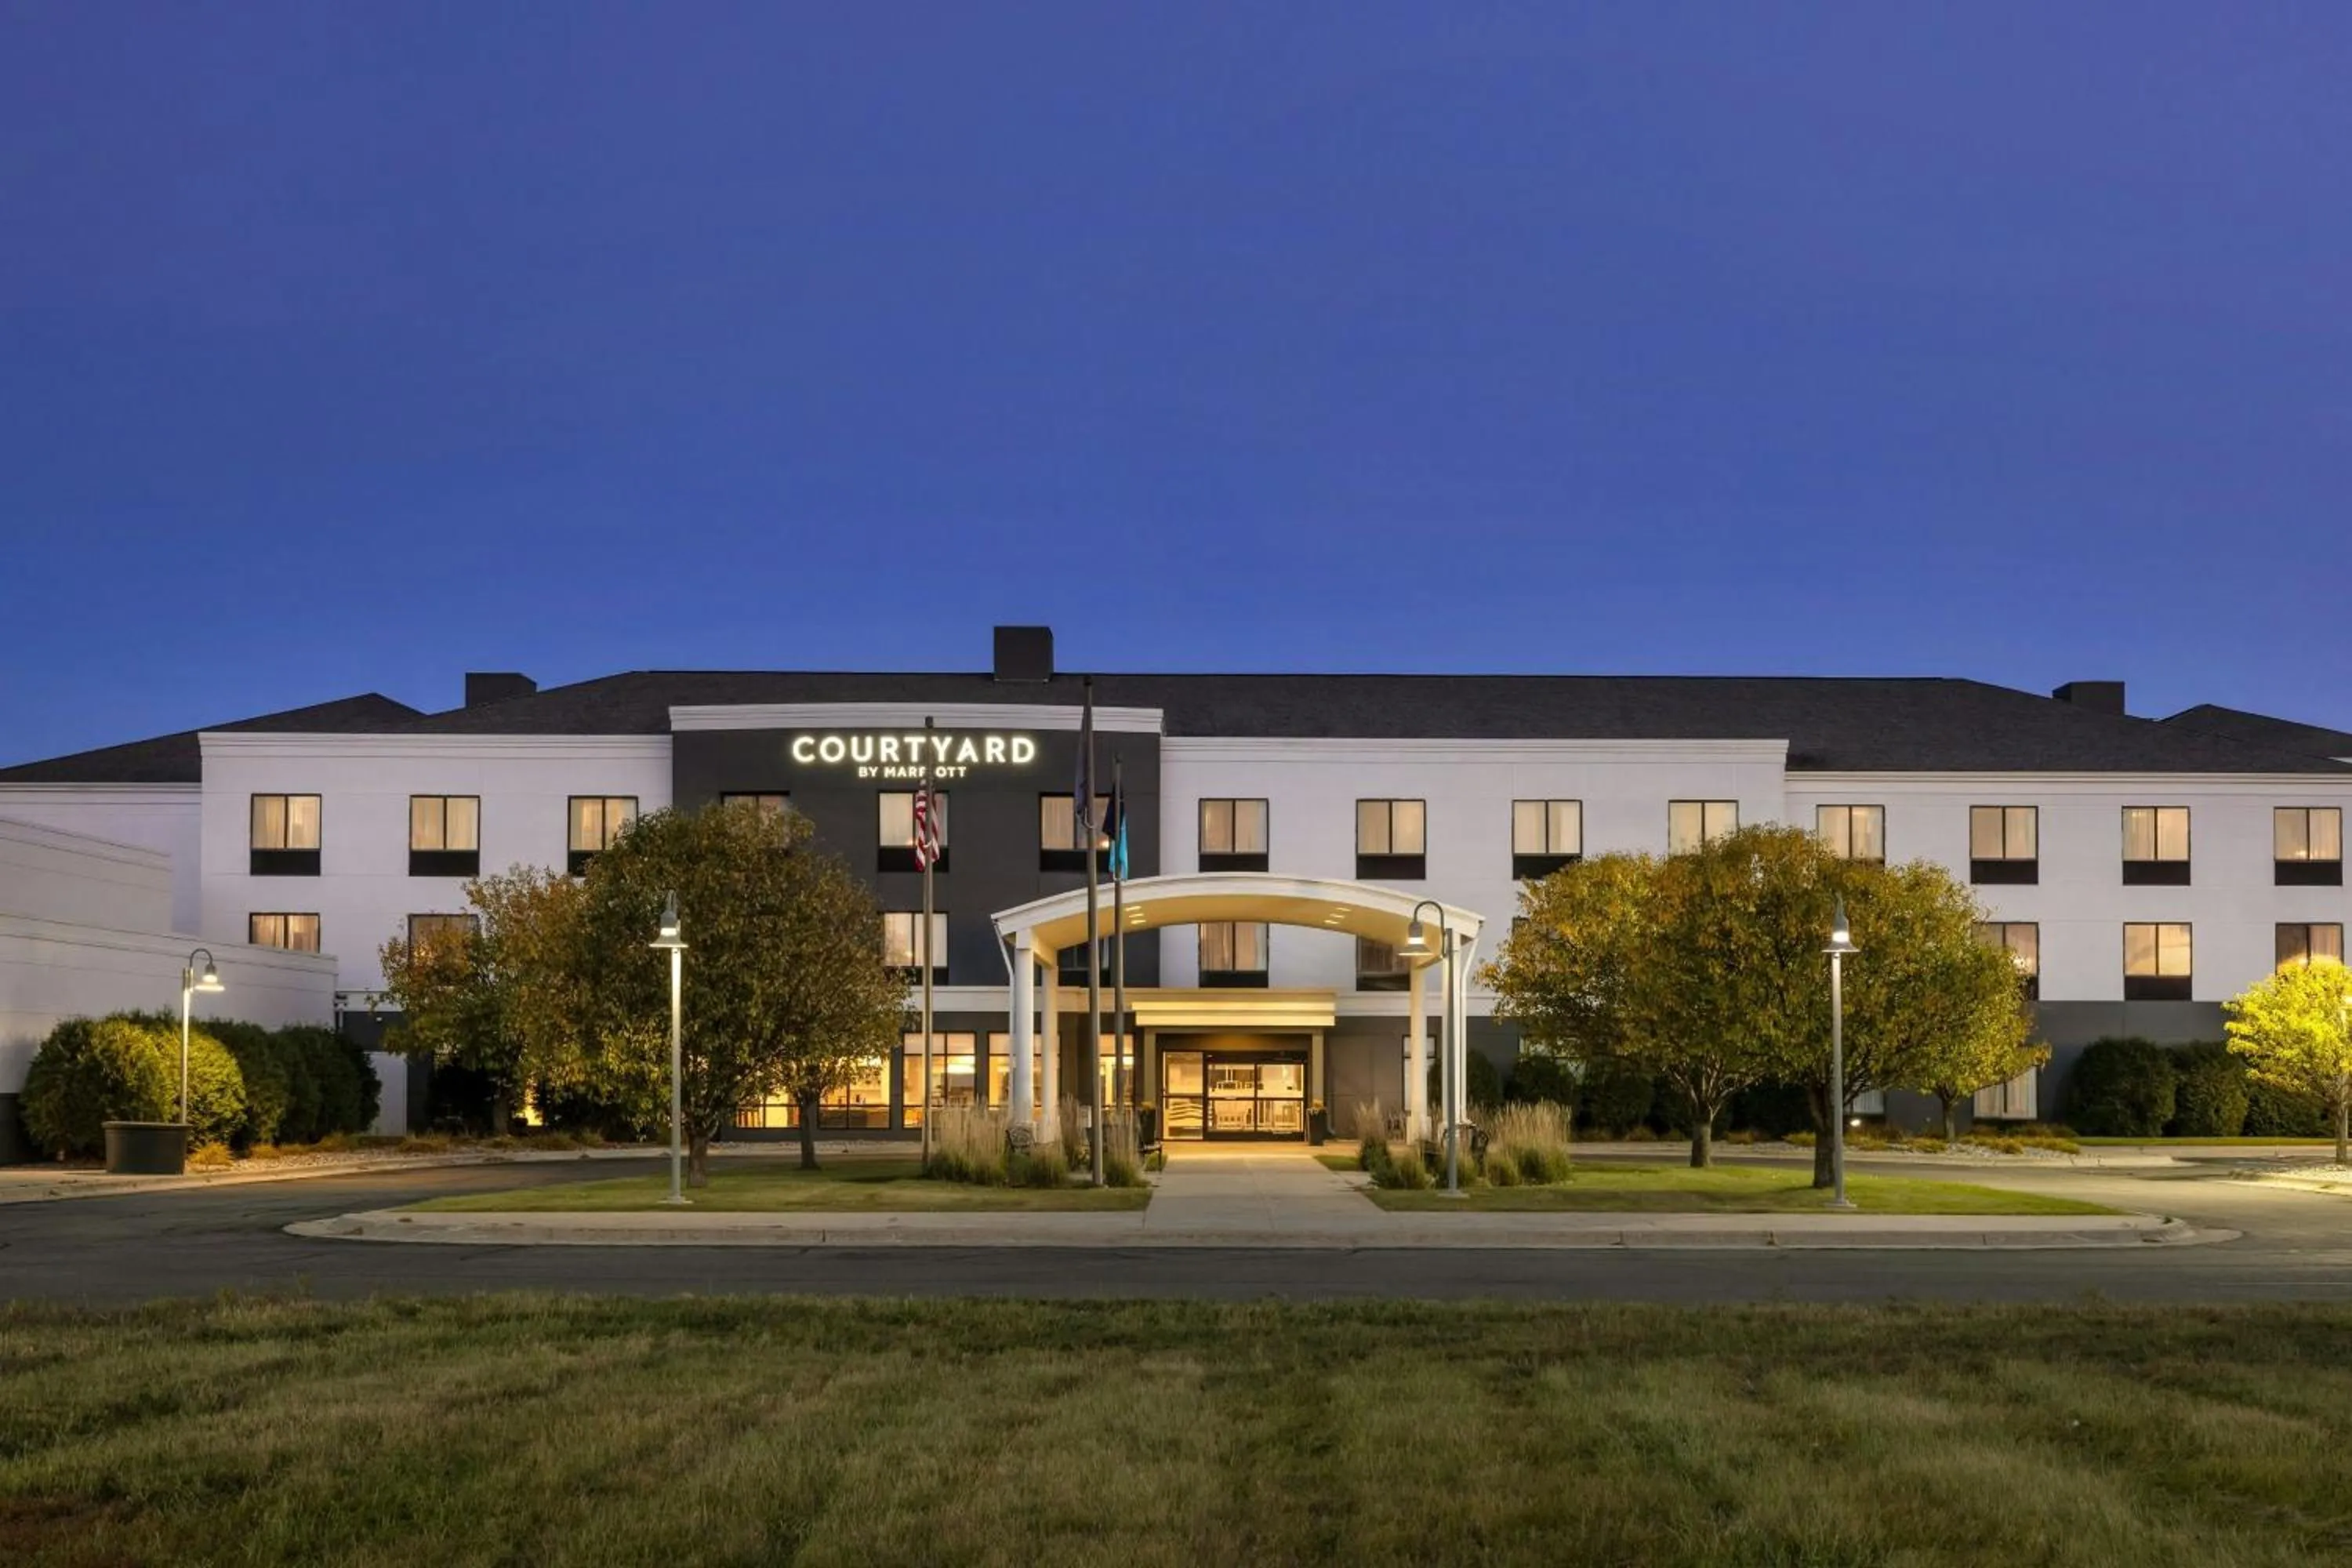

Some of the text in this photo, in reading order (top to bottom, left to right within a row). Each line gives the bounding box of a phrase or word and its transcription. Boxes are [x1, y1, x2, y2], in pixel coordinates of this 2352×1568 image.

[792, 735, 1036, 764] COURTYARD
[858, 766, 967, 778] BY MARROTT
